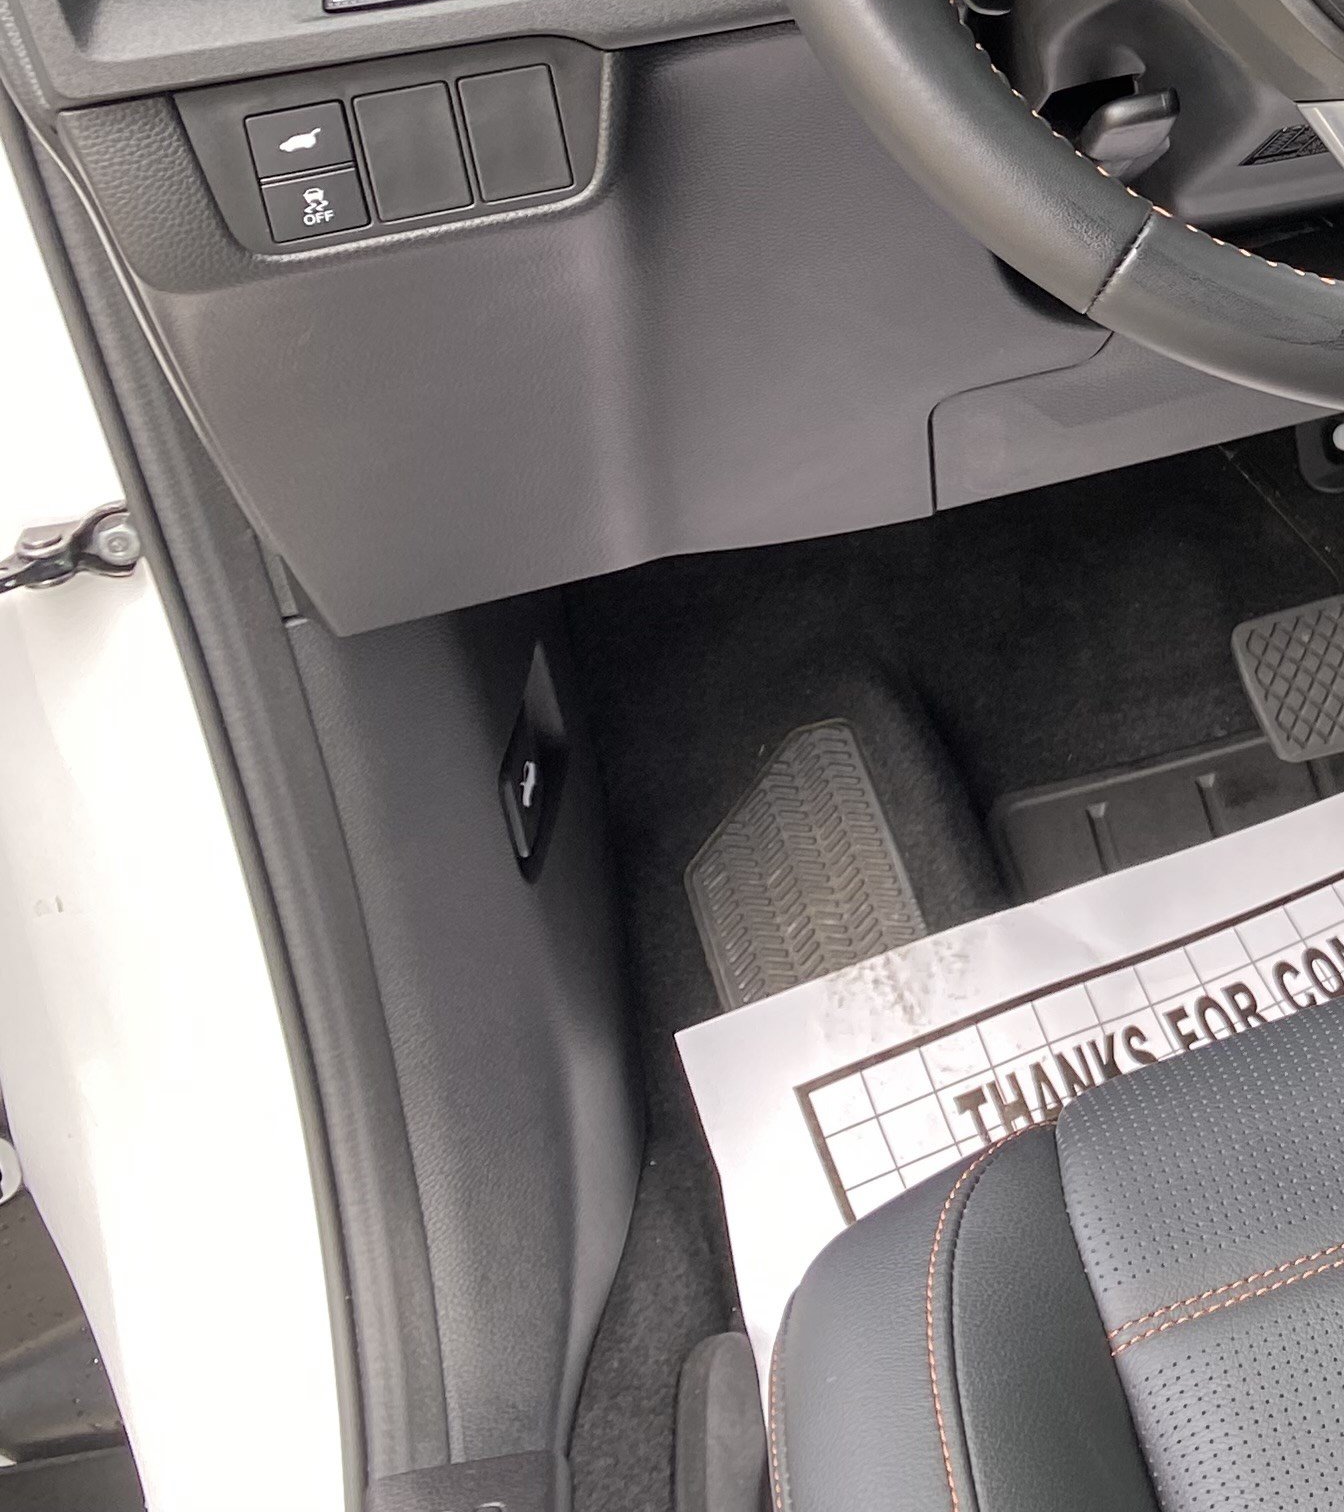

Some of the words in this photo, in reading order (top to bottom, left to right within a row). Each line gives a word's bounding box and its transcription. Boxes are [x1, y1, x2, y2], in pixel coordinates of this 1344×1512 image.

[303, 207, 335, 226] OFF
[953, 1024, 1158, 1146] THANKS
[1166, 981, 1268, 1051] FOR
